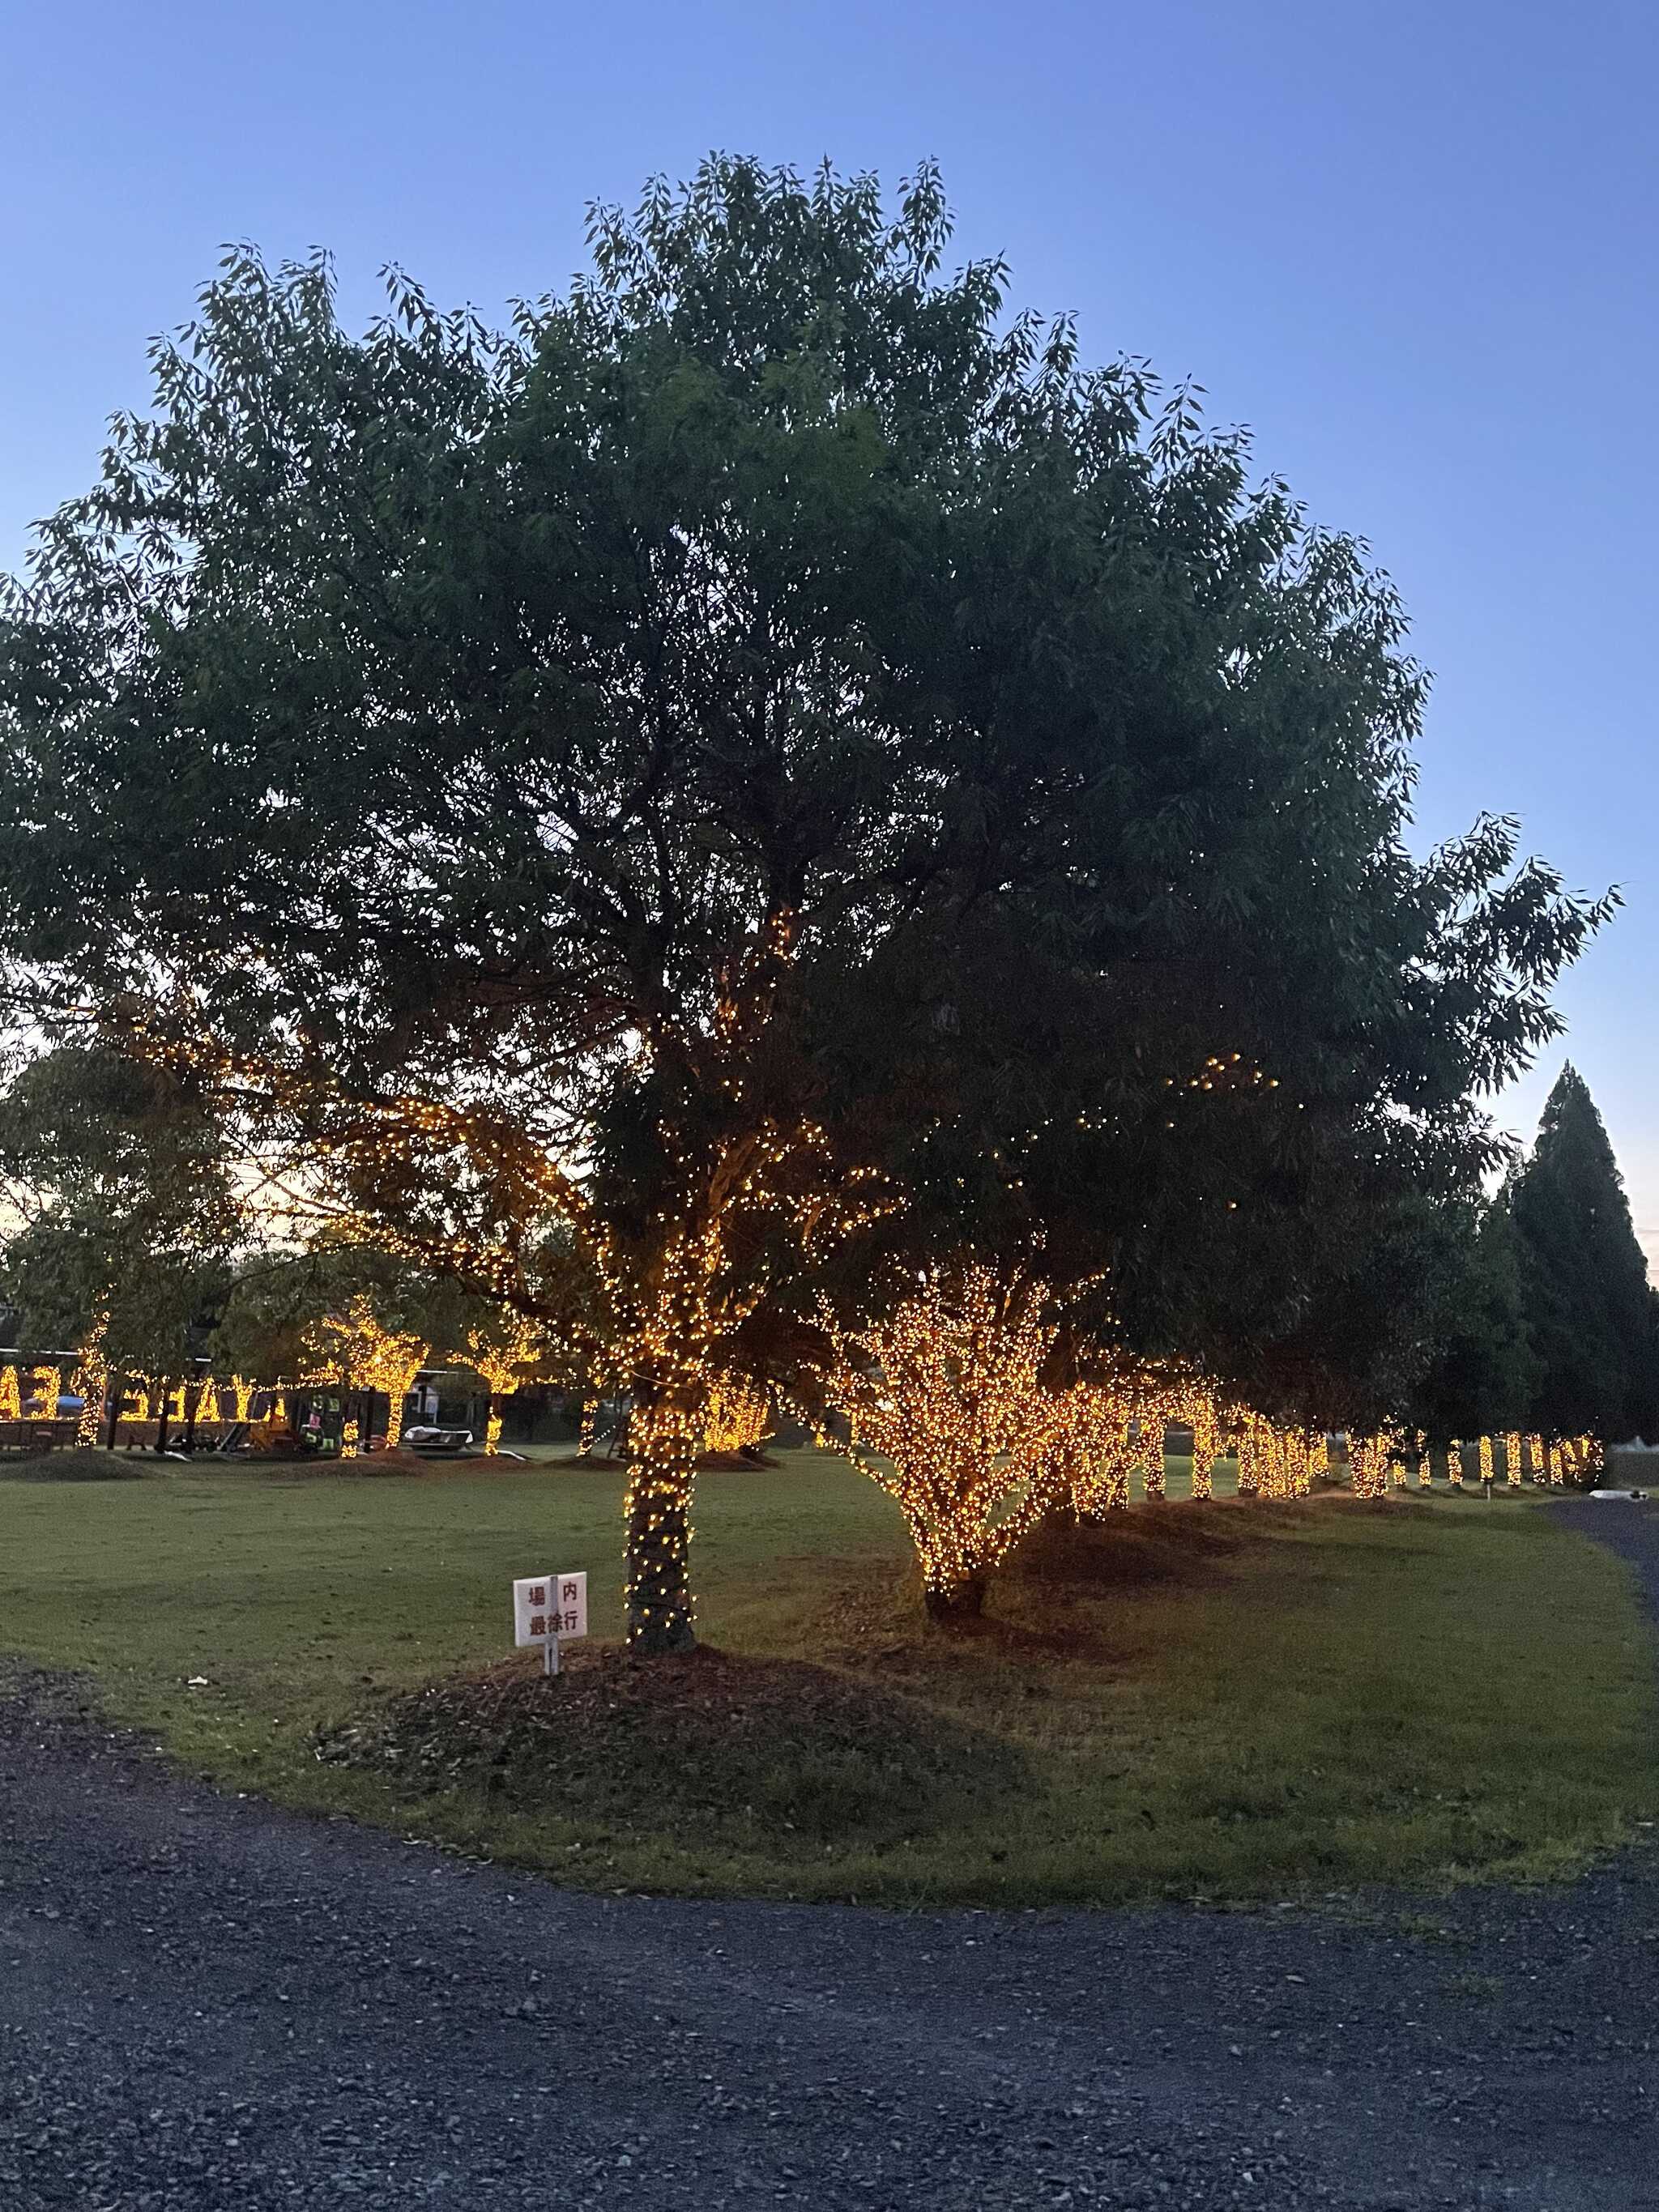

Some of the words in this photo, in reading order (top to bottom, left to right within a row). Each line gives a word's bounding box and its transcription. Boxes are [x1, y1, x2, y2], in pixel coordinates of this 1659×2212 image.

[528, 1582, 577, 1606] 場内
[530, 1610, 578, 1635] 最徐行
